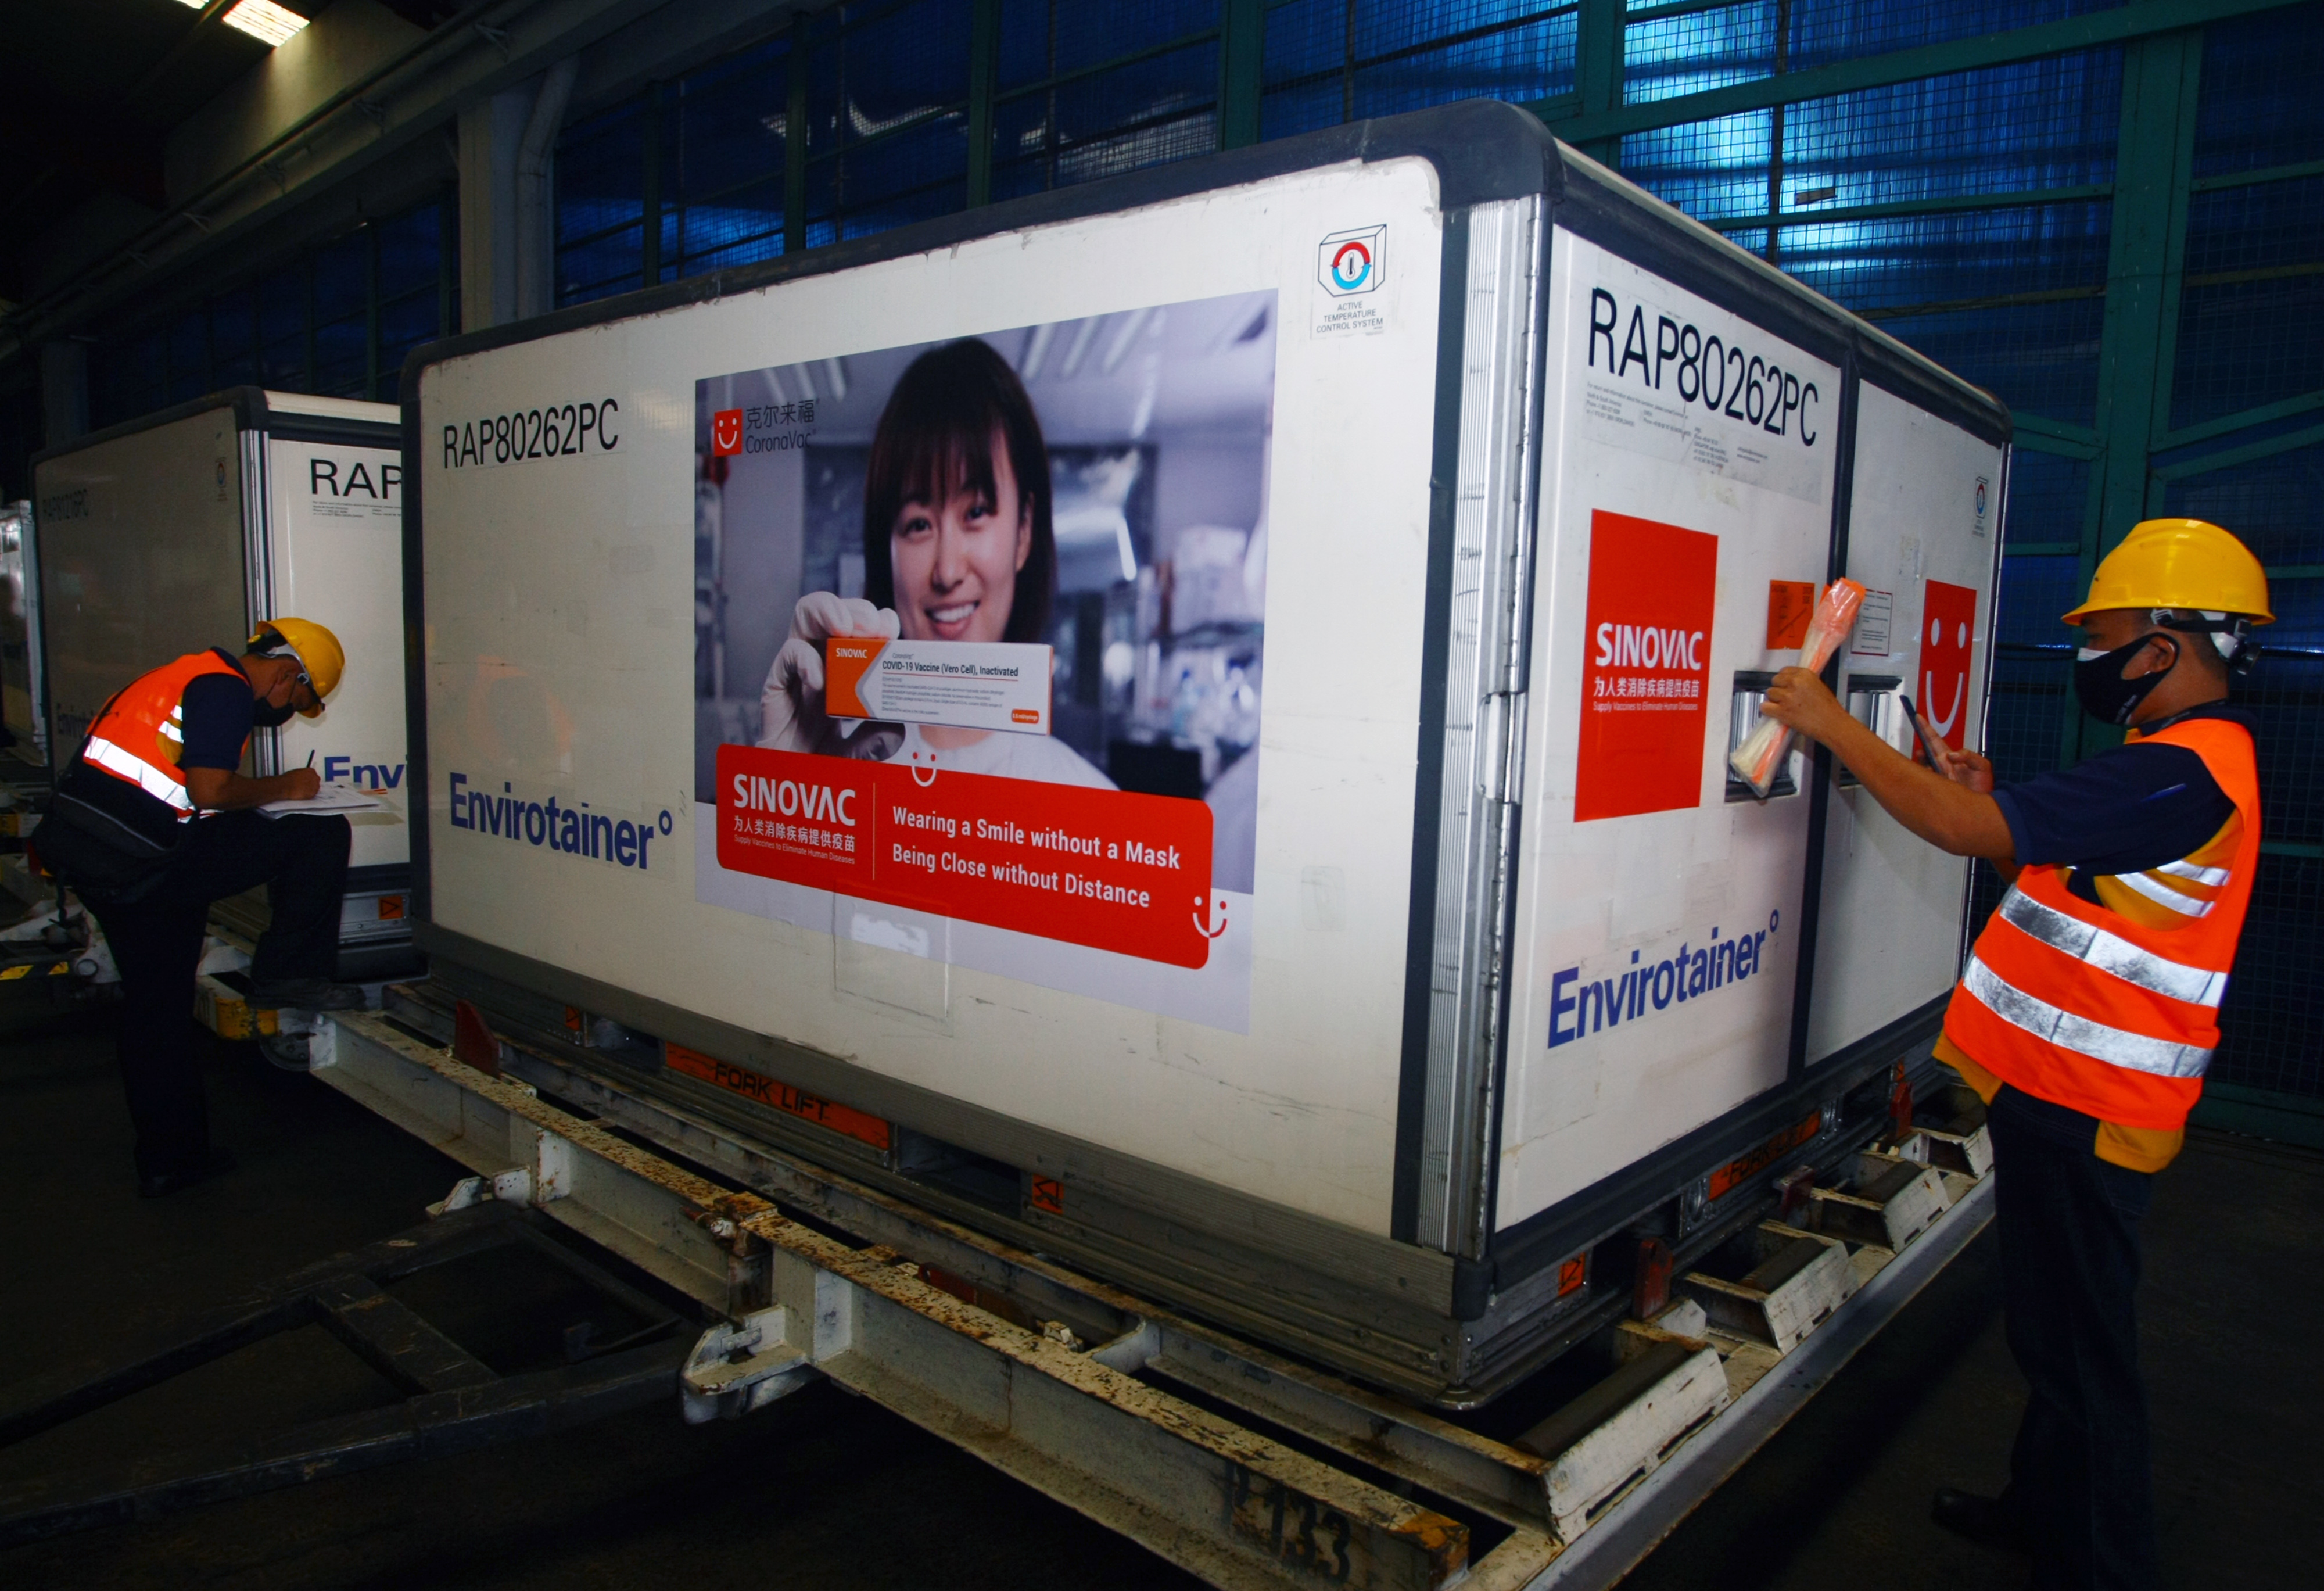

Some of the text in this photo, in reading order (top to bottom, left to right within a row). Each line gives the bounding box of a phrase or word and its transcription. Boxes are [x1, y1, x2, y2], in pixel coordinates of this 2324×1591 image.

[1324, 308, 1376, 322] TEMPERATURE
[1337, 300, 1363, 311] ACTIVE
[1317, 317, 1383, 333] CONTROL SYSTEM
[1588, 286, 1819, 447] RAP80262PC
[746, 399, 815, 430] 克尔来福
[444, 399, 619, 469] RAP80262PC
[745, 430, 813, 454] CoronaVac
[835, 648, 868, 658] SINOVAC
[1595, 622, 1703, 671] SINOVAC
[882, 661, 1018, 677] COVID-19 Vaccine (Vero Cell), Inactivated
[1593, 701, 1612, 712] Supply
[734, 773, 856, 827] SINOVAC
[734, 815, 855, 853] 为人类消除疾病提供疫苗
[734, 834, 855, 865] Supply Vaccines to Eliminate Human Diseases
[893, 805, 1181, 870] Wearing a Smile without a Mask
[892, 843, 1150, 908] Being Close without Distance
[715, 1062, 830, 1121] FORK LIFT
